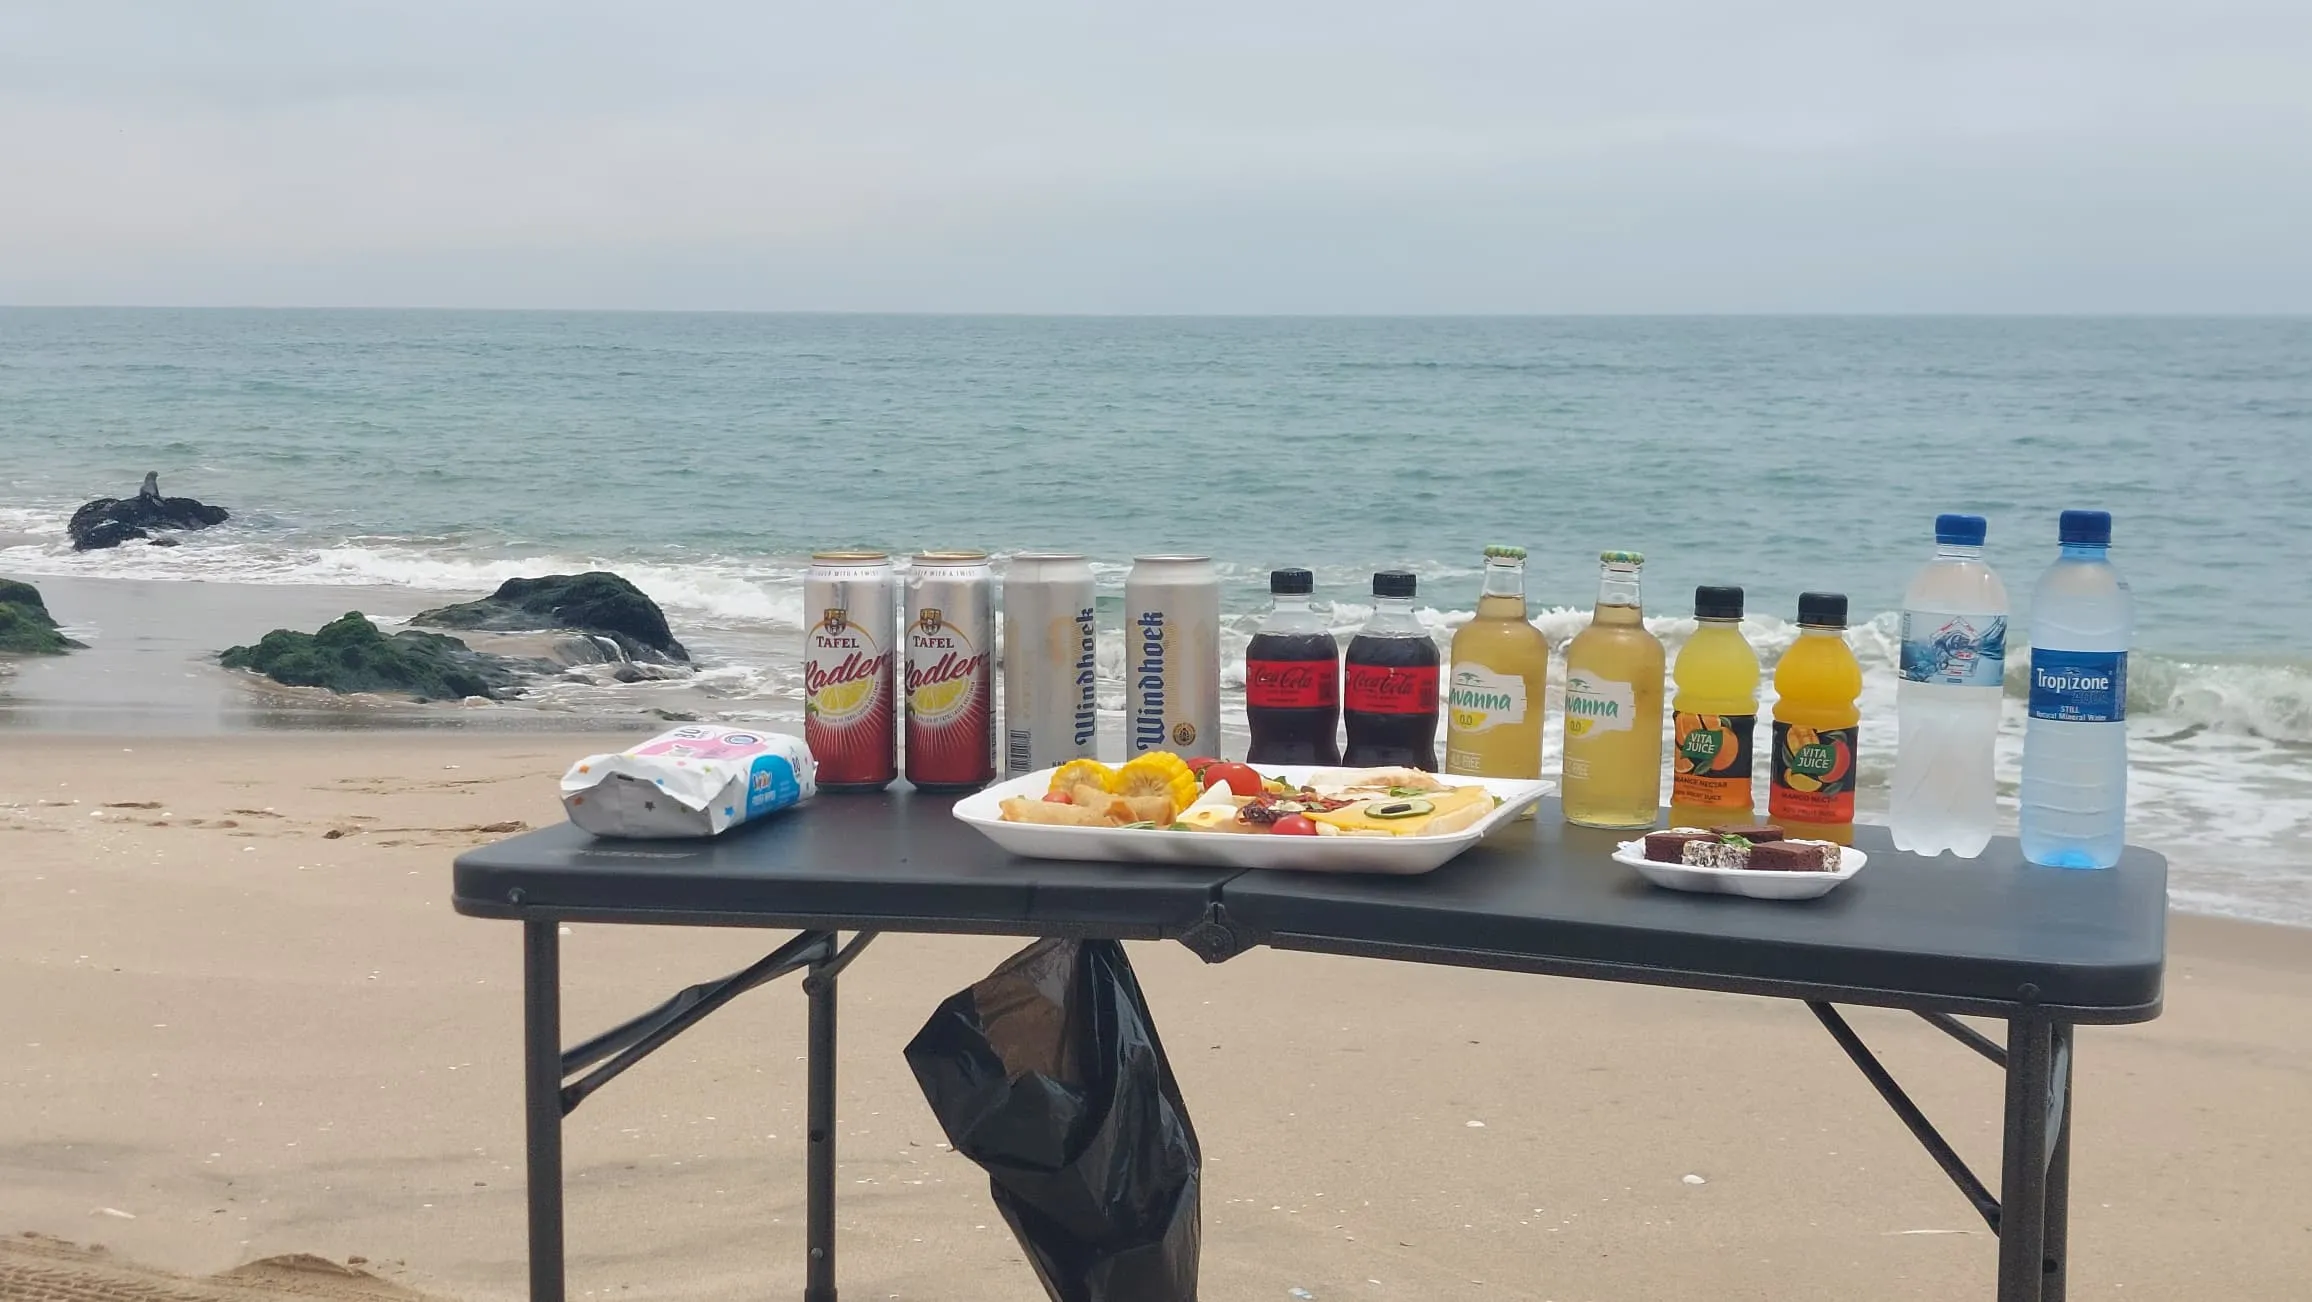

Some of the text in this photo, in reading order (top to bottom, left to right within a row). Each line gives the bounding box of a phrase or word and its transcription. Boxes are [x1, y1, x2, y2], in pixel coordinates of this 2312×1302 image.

[816, 635, 860, 649] TAFEL
[912, 635, 955, 649] TAFEL
[1075, 607, 1095, 746] Windhoek
[1136, 611, 1165, 750] Windhoek
[1255, 665, 1314, 689] Coca-Cola
[1353, 671, 1417, 696] Coca-Cola
[2036, 667, 2109, 694] Tropizone
[1449, 687, 1512, 712] avanna
[1565, 694, 1619, 718] vanna
[2058, 711, 2086, 720] Mineral
[2060, 705, 2080, 714] STILL
[1691, 732, 1713, 745] VITA
[1686, 742, 1716, 754] JUICE
[1802, 747, 1827, 759] VITA
[1797, 757, 1831, 769] JUICE
